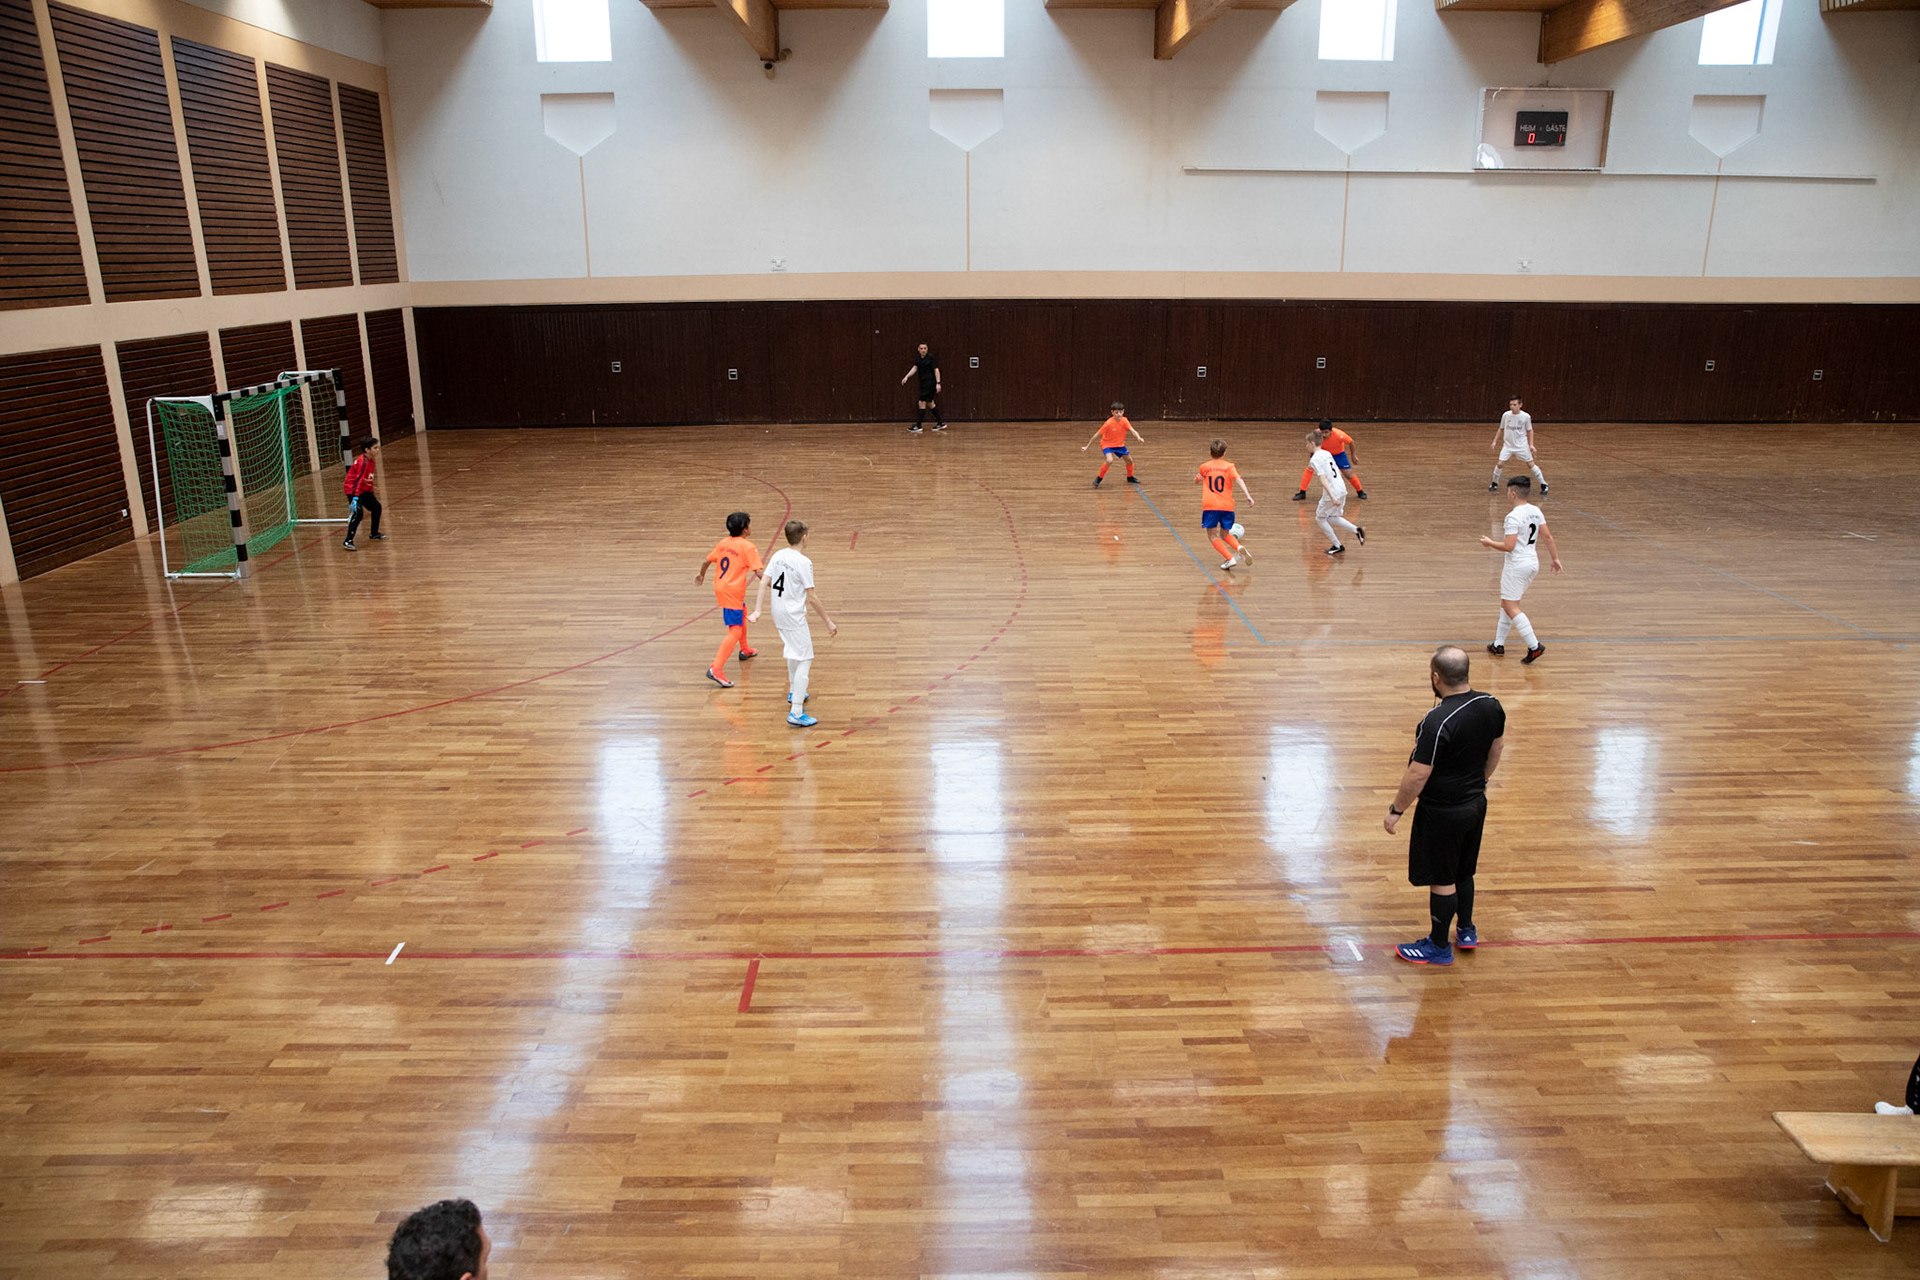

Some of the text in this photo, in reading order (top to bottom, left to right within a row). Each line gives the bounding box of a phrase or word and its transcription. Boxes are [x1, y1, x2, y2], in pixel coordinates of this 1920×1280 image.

[1519, 124, 1537, 132] HEIM
[1527, 132, 1536, 144] 0
[1208, 475, 1225, 493] 10
[1527, 522, 1537, 546] 2
[719, 556, 730, 579] 9
[772, 571, 785, 597] 4
